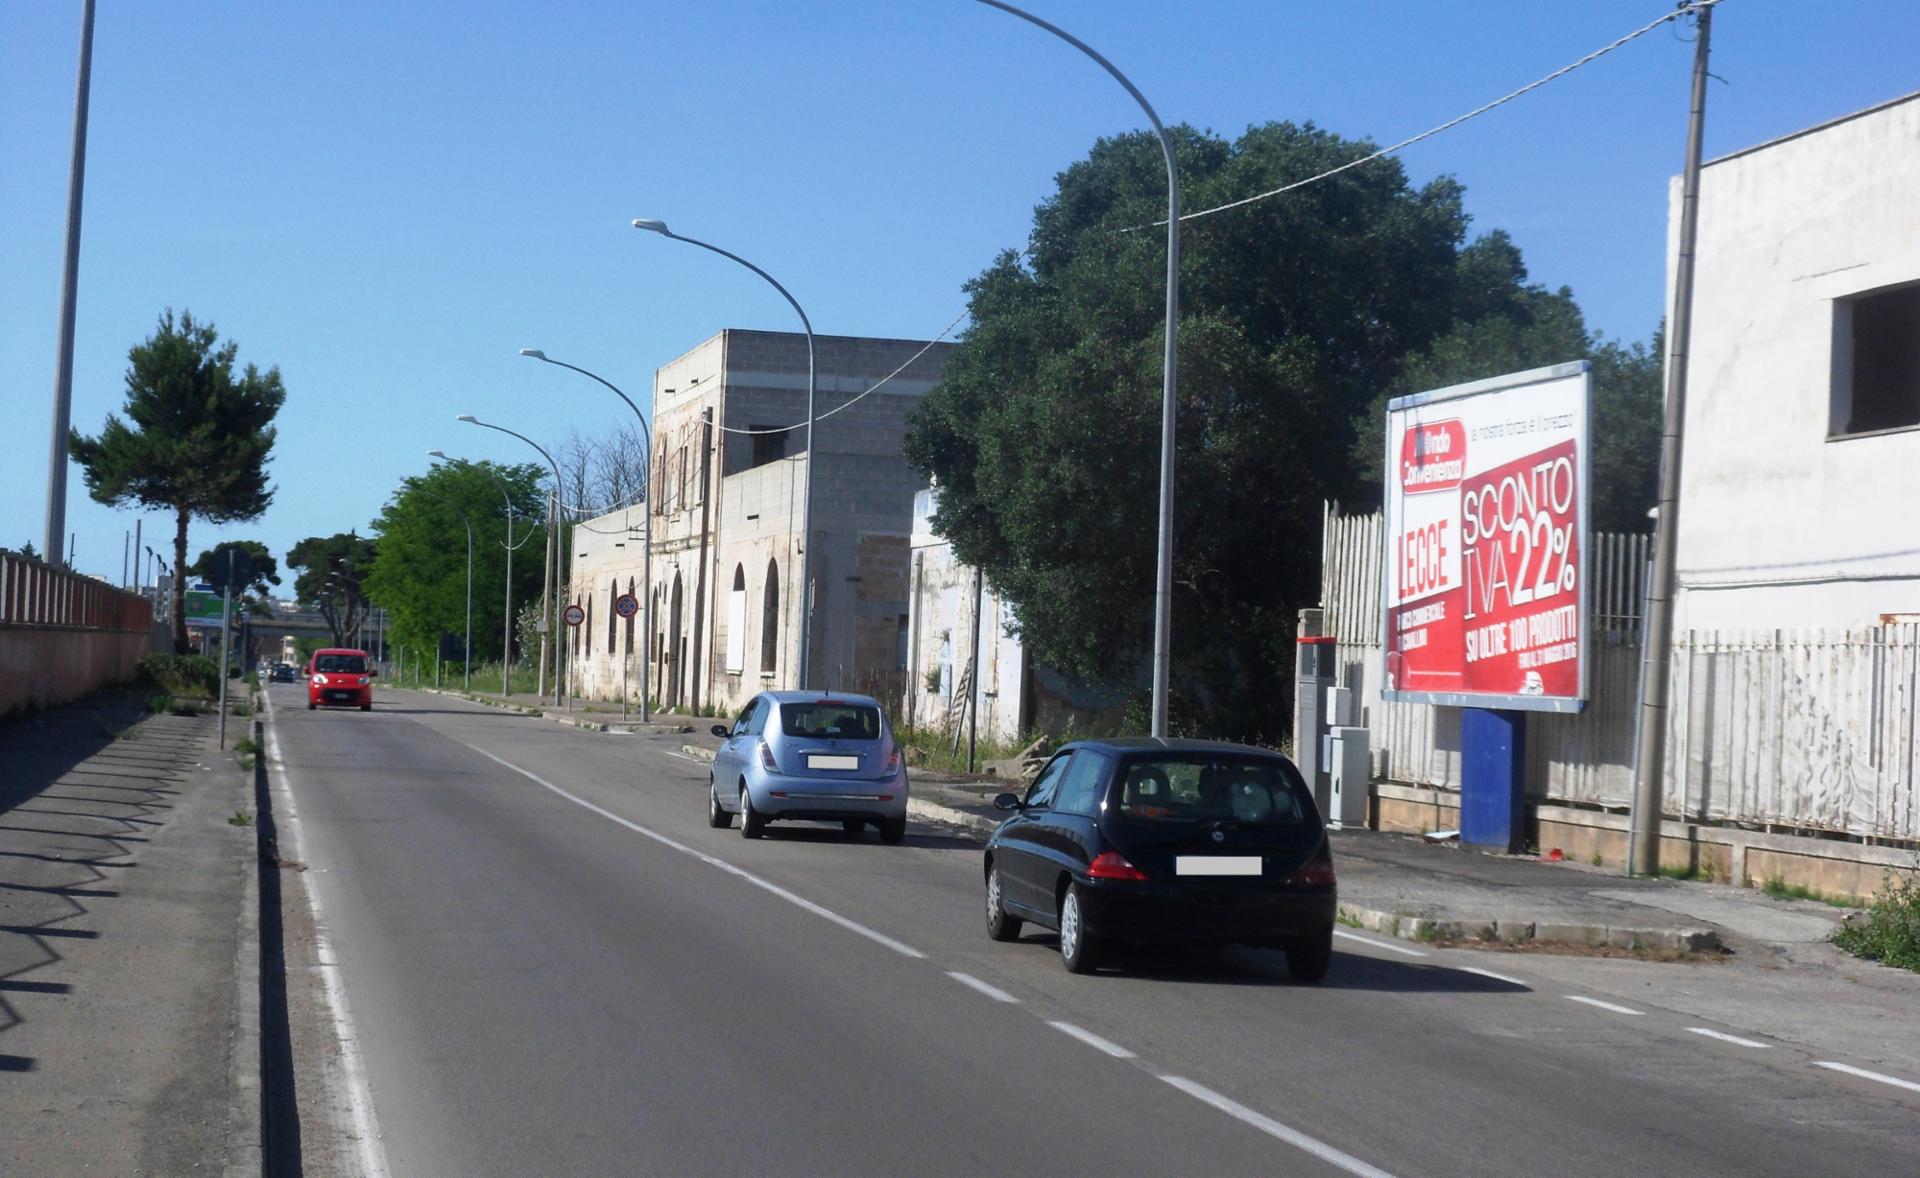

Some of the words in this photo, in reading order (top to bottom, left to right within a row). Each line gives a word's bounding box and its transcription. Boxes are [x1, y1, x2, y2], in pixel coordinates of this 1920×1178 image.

[1463, 456, 1574, 545] SCONTO
[1397, 519, 1448, 599] LECCE
[1463, 539, 1513, 619] IVA
[1466, 630, 1479, 662] SU
[1480, 622, 1507, 659] OLTRE
[1509, 617, 1528, 652] 100
[1529, 604, 1576, 648] PRODOTTI
